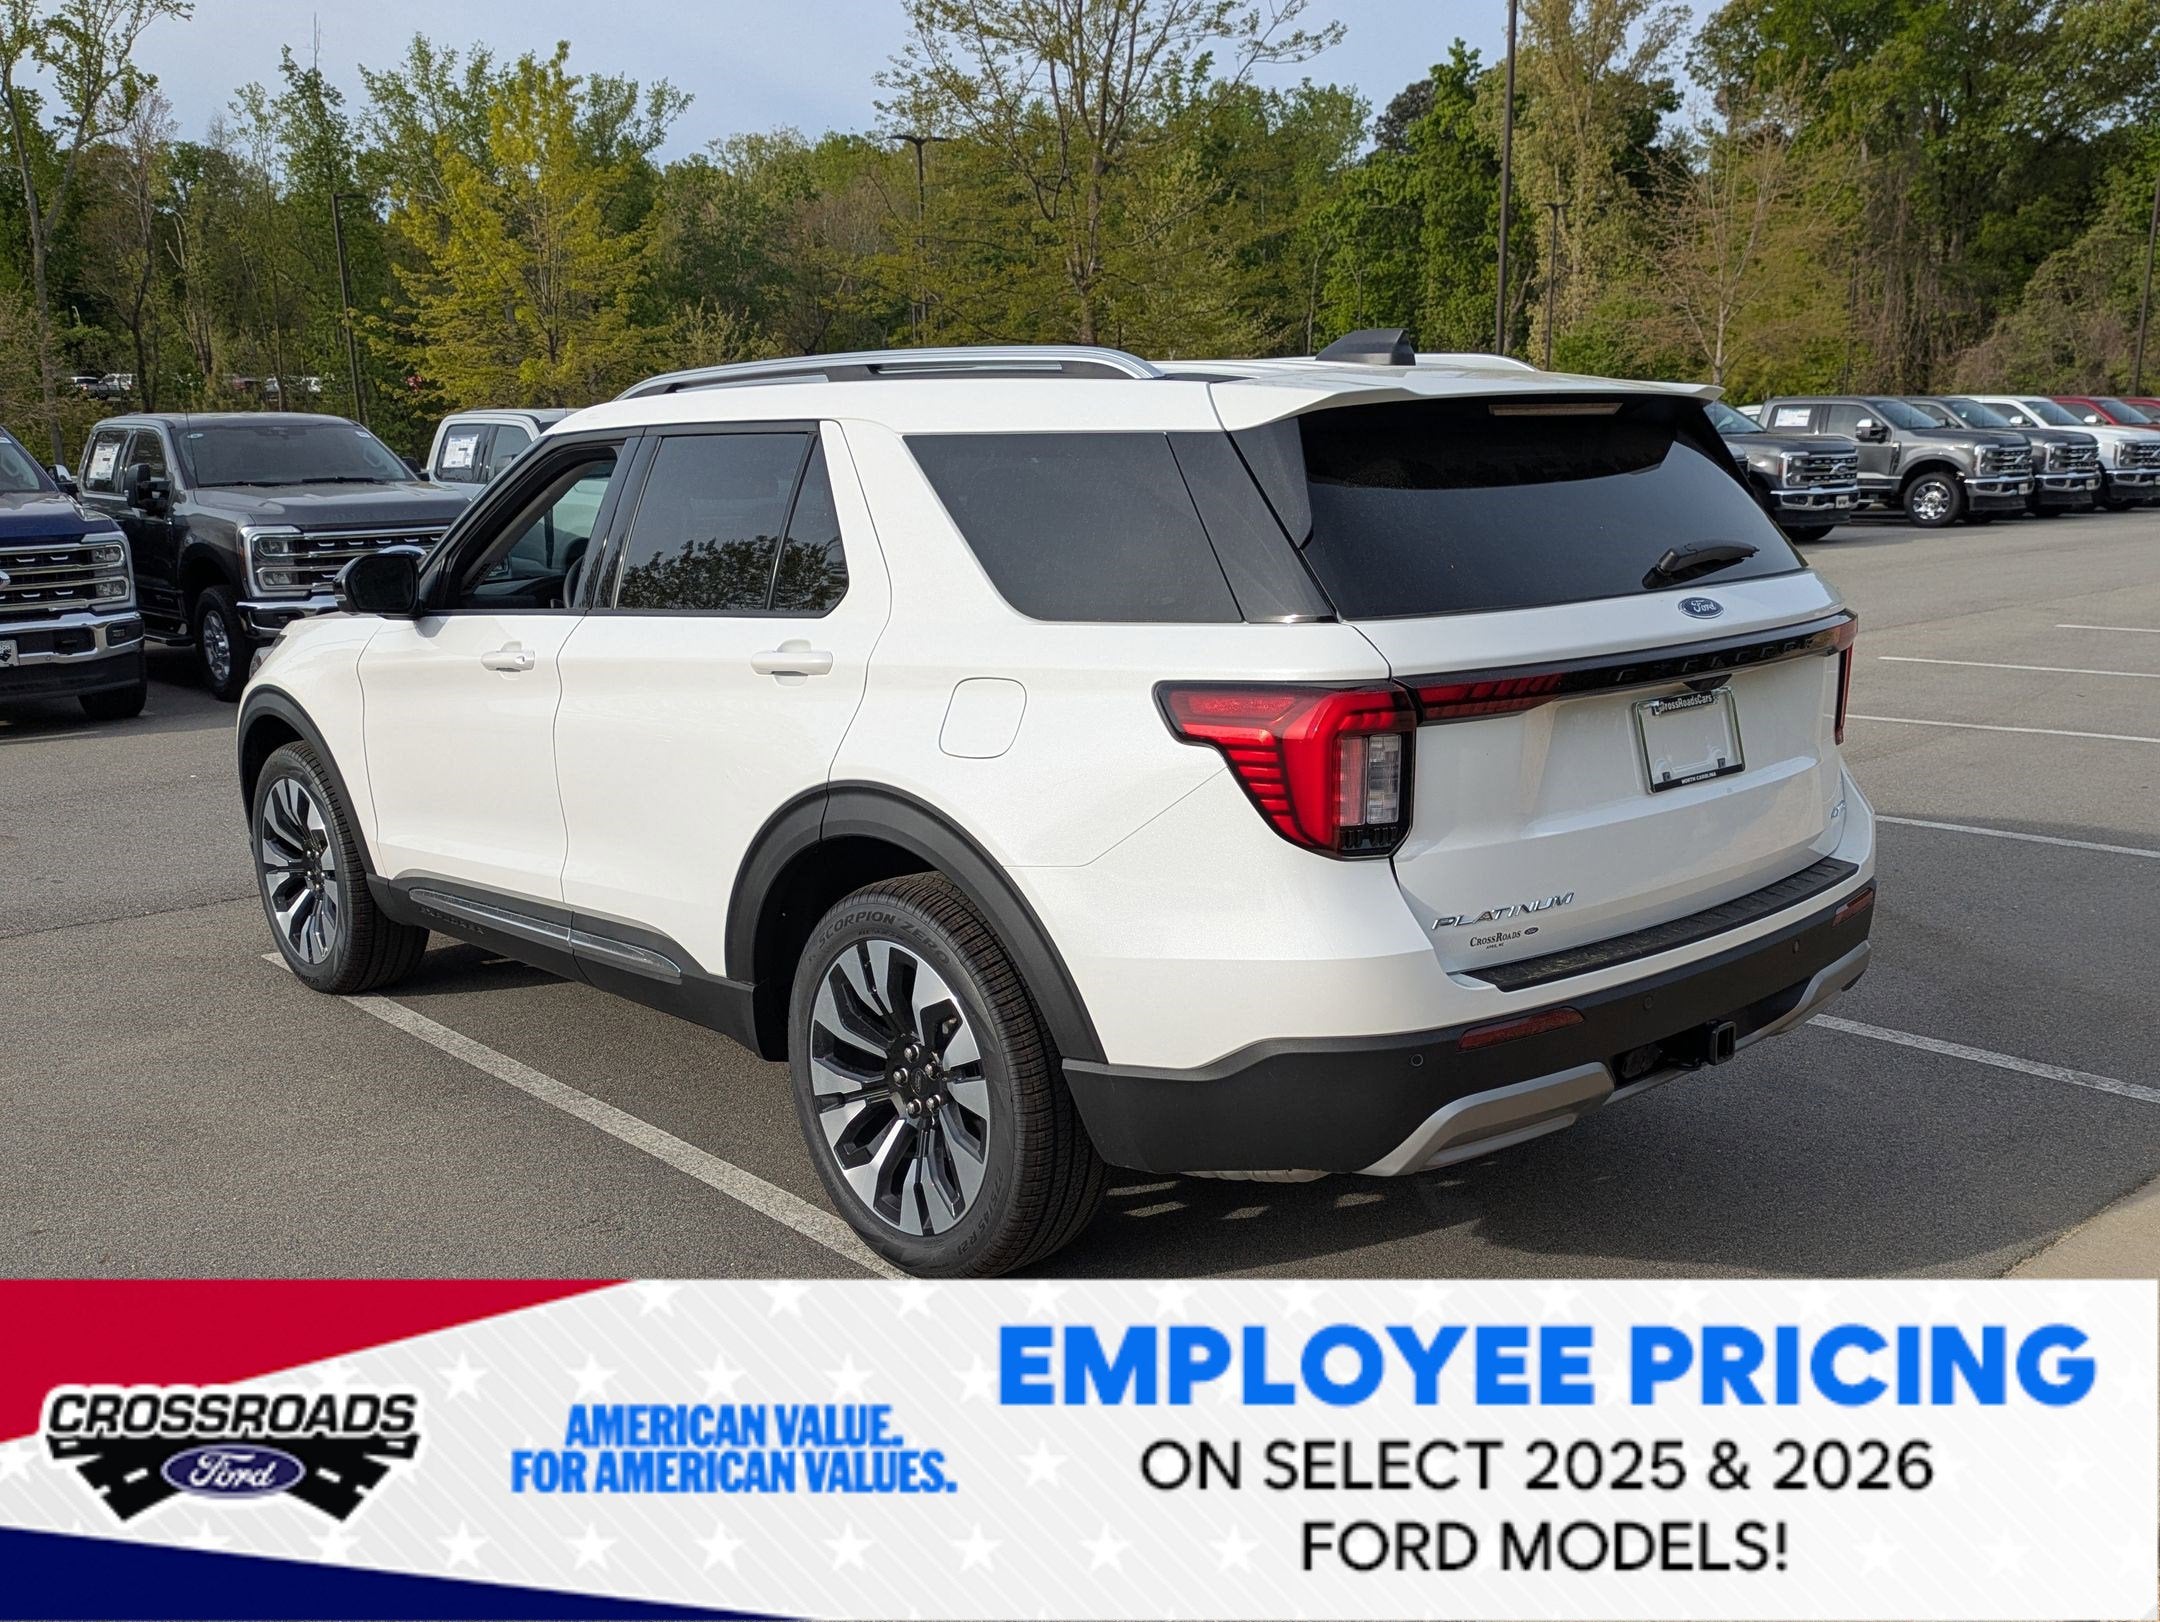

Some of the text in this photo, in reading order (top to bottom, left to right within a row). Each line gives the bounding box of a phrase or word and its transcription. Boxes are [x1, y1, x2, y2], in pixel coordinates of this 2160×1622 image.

[1691, 600, 1717, 613] Ford
[1431, 892, 1575, 931] PLATINUM
[819, 911, 897, 949] SCORPION
[900, 921, 951, 965] ZERO
